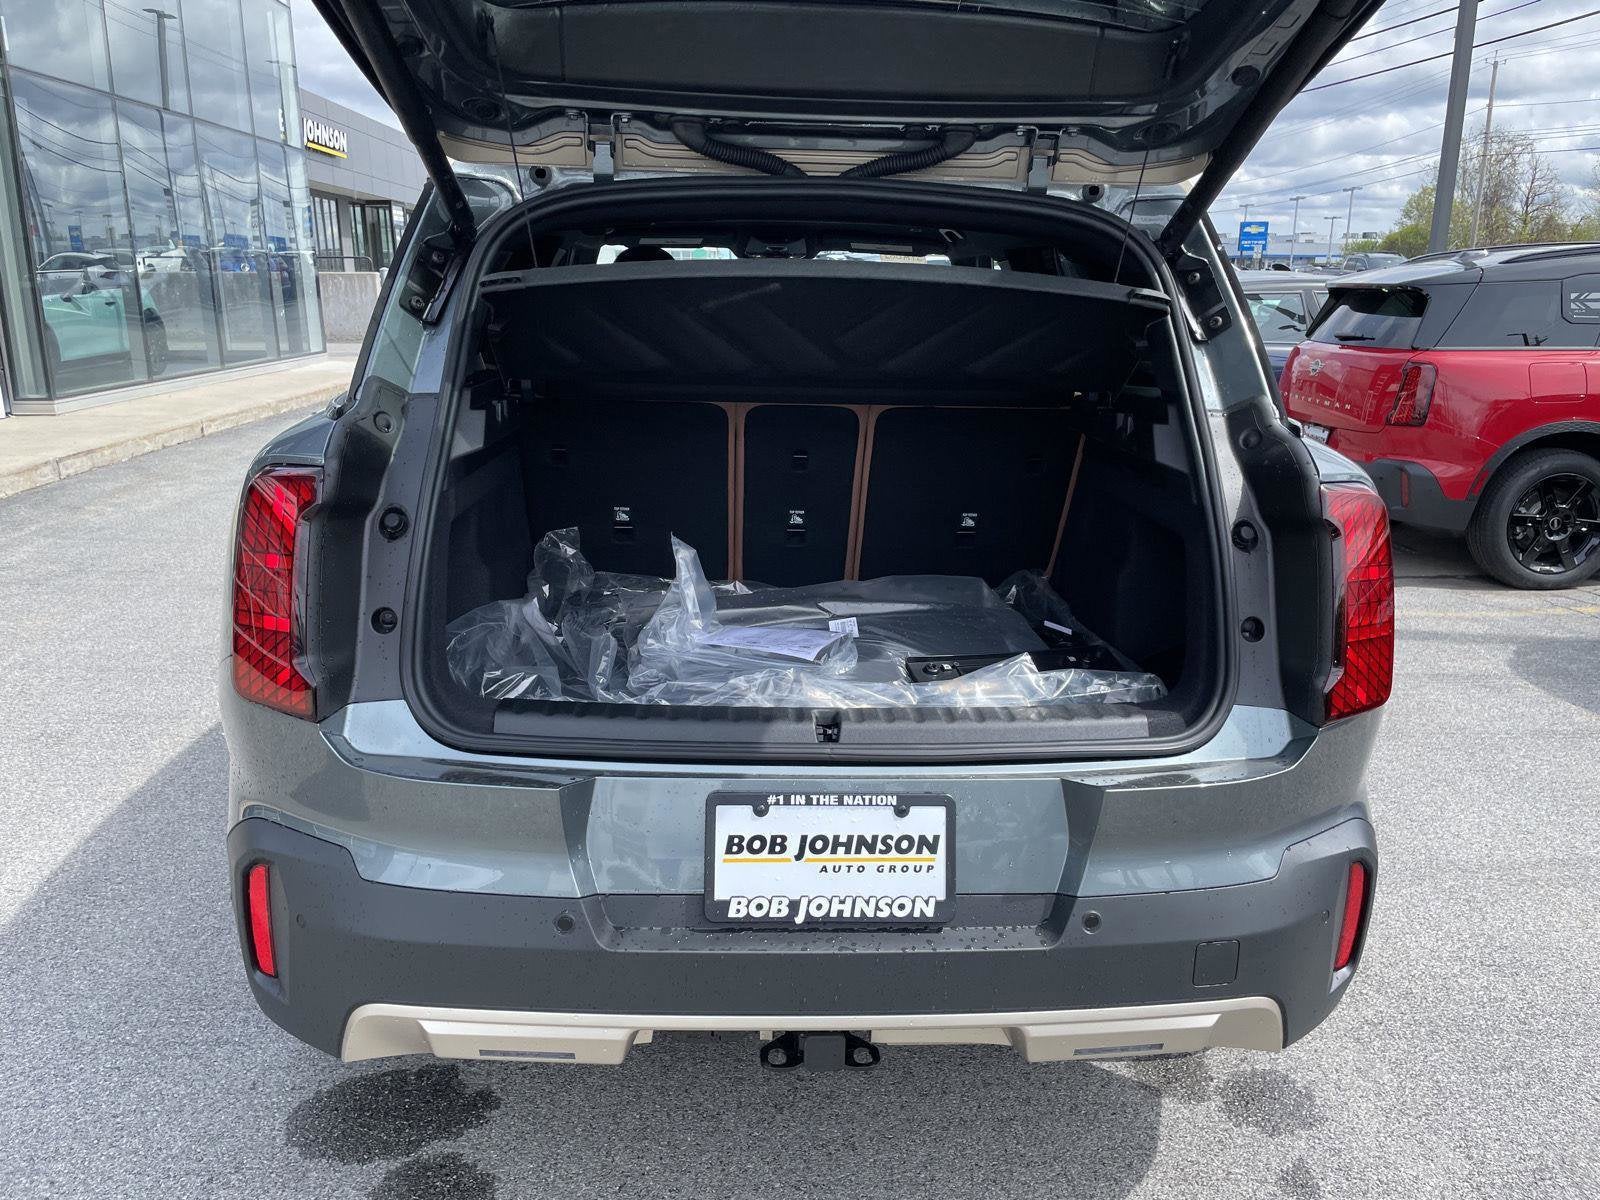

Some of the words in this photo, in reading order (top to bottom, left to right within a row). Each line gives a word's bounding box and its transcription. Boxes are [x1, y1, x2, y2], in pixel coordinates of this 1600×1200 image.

[303, 117, 347, 152] JOHNSON
[1280, 390, 1351, 409] ONTRYMAN
[767, 795, 784, 805] #1
[790, 795, 806, 805] IN
[810, 795, 839, 805] THE
[843, 795, 897, 806] NATION
[724, 834, 788, 855] BOB
[794, 834, 940, 861] JOHNSON
[819, 865, 866, 873] AUTO
[876, 865, 935, 874] GROUP
[727, 896, 790, 918] BOB
[794, 896, 936, 924] JOHNSON
